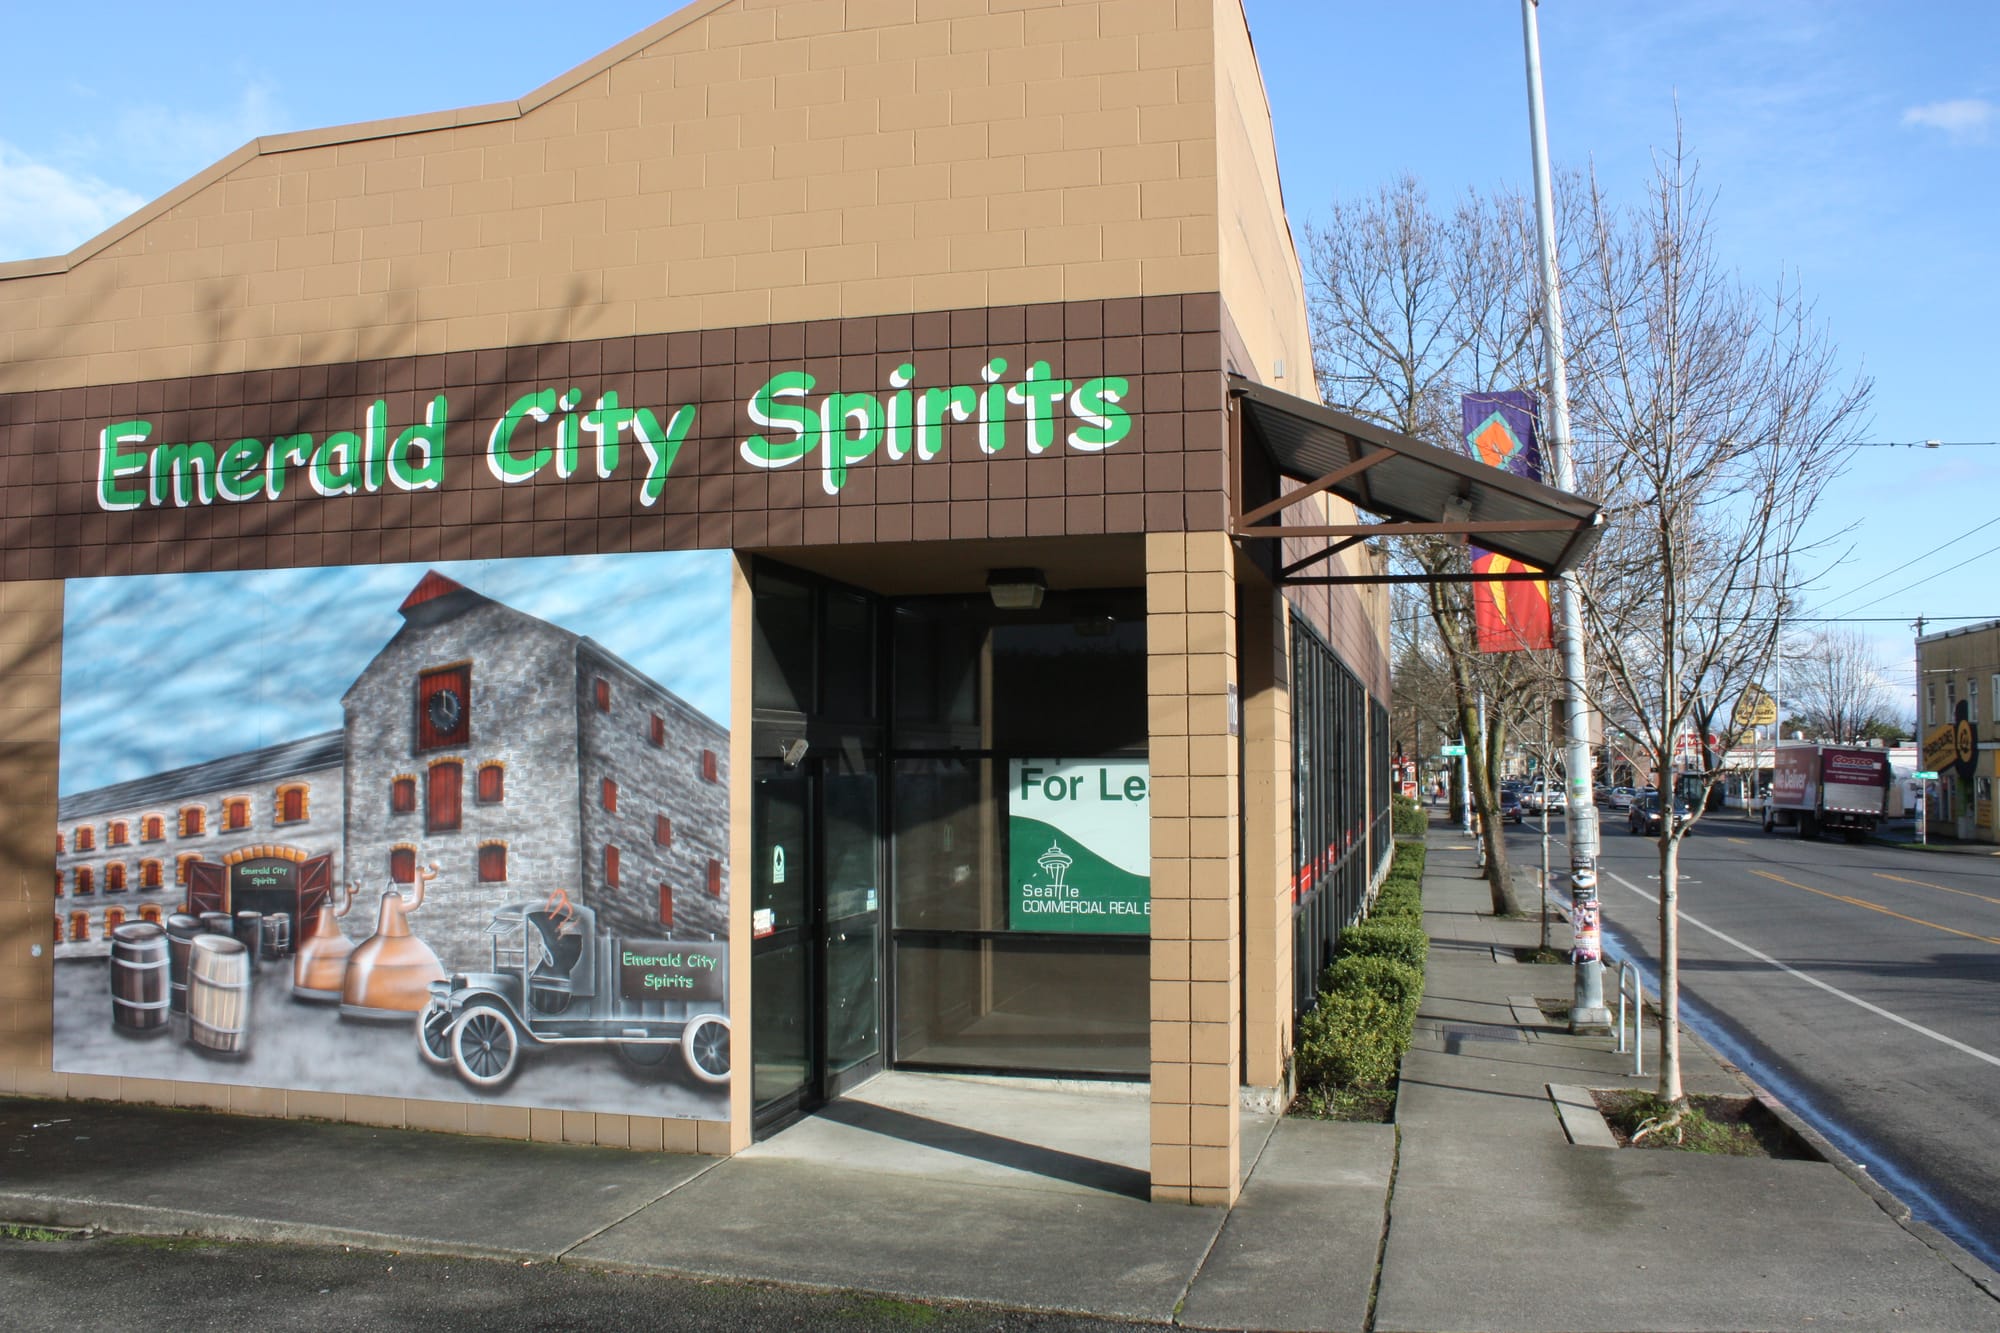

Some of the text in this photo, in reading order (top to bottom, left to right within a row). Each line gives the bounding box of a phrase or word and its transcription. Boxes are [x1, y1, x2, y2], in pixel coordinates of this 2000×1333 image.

[97, 357, 1132, 511] Emerald City Spirits
[1021, 768, 1149, 801] For Le
[241, 867, 288, 876] Emerald City
[251, 877, 277, 886] Spirits
[1022, 884, 1080, 900] Seattle
[1022, 900, 1105, 914] COMMERCIAL
[1109, 902, 1141, 915] REAL
[623, 952, 717, 972] Emerald City
[644, 973, 694, 990] Spirits
